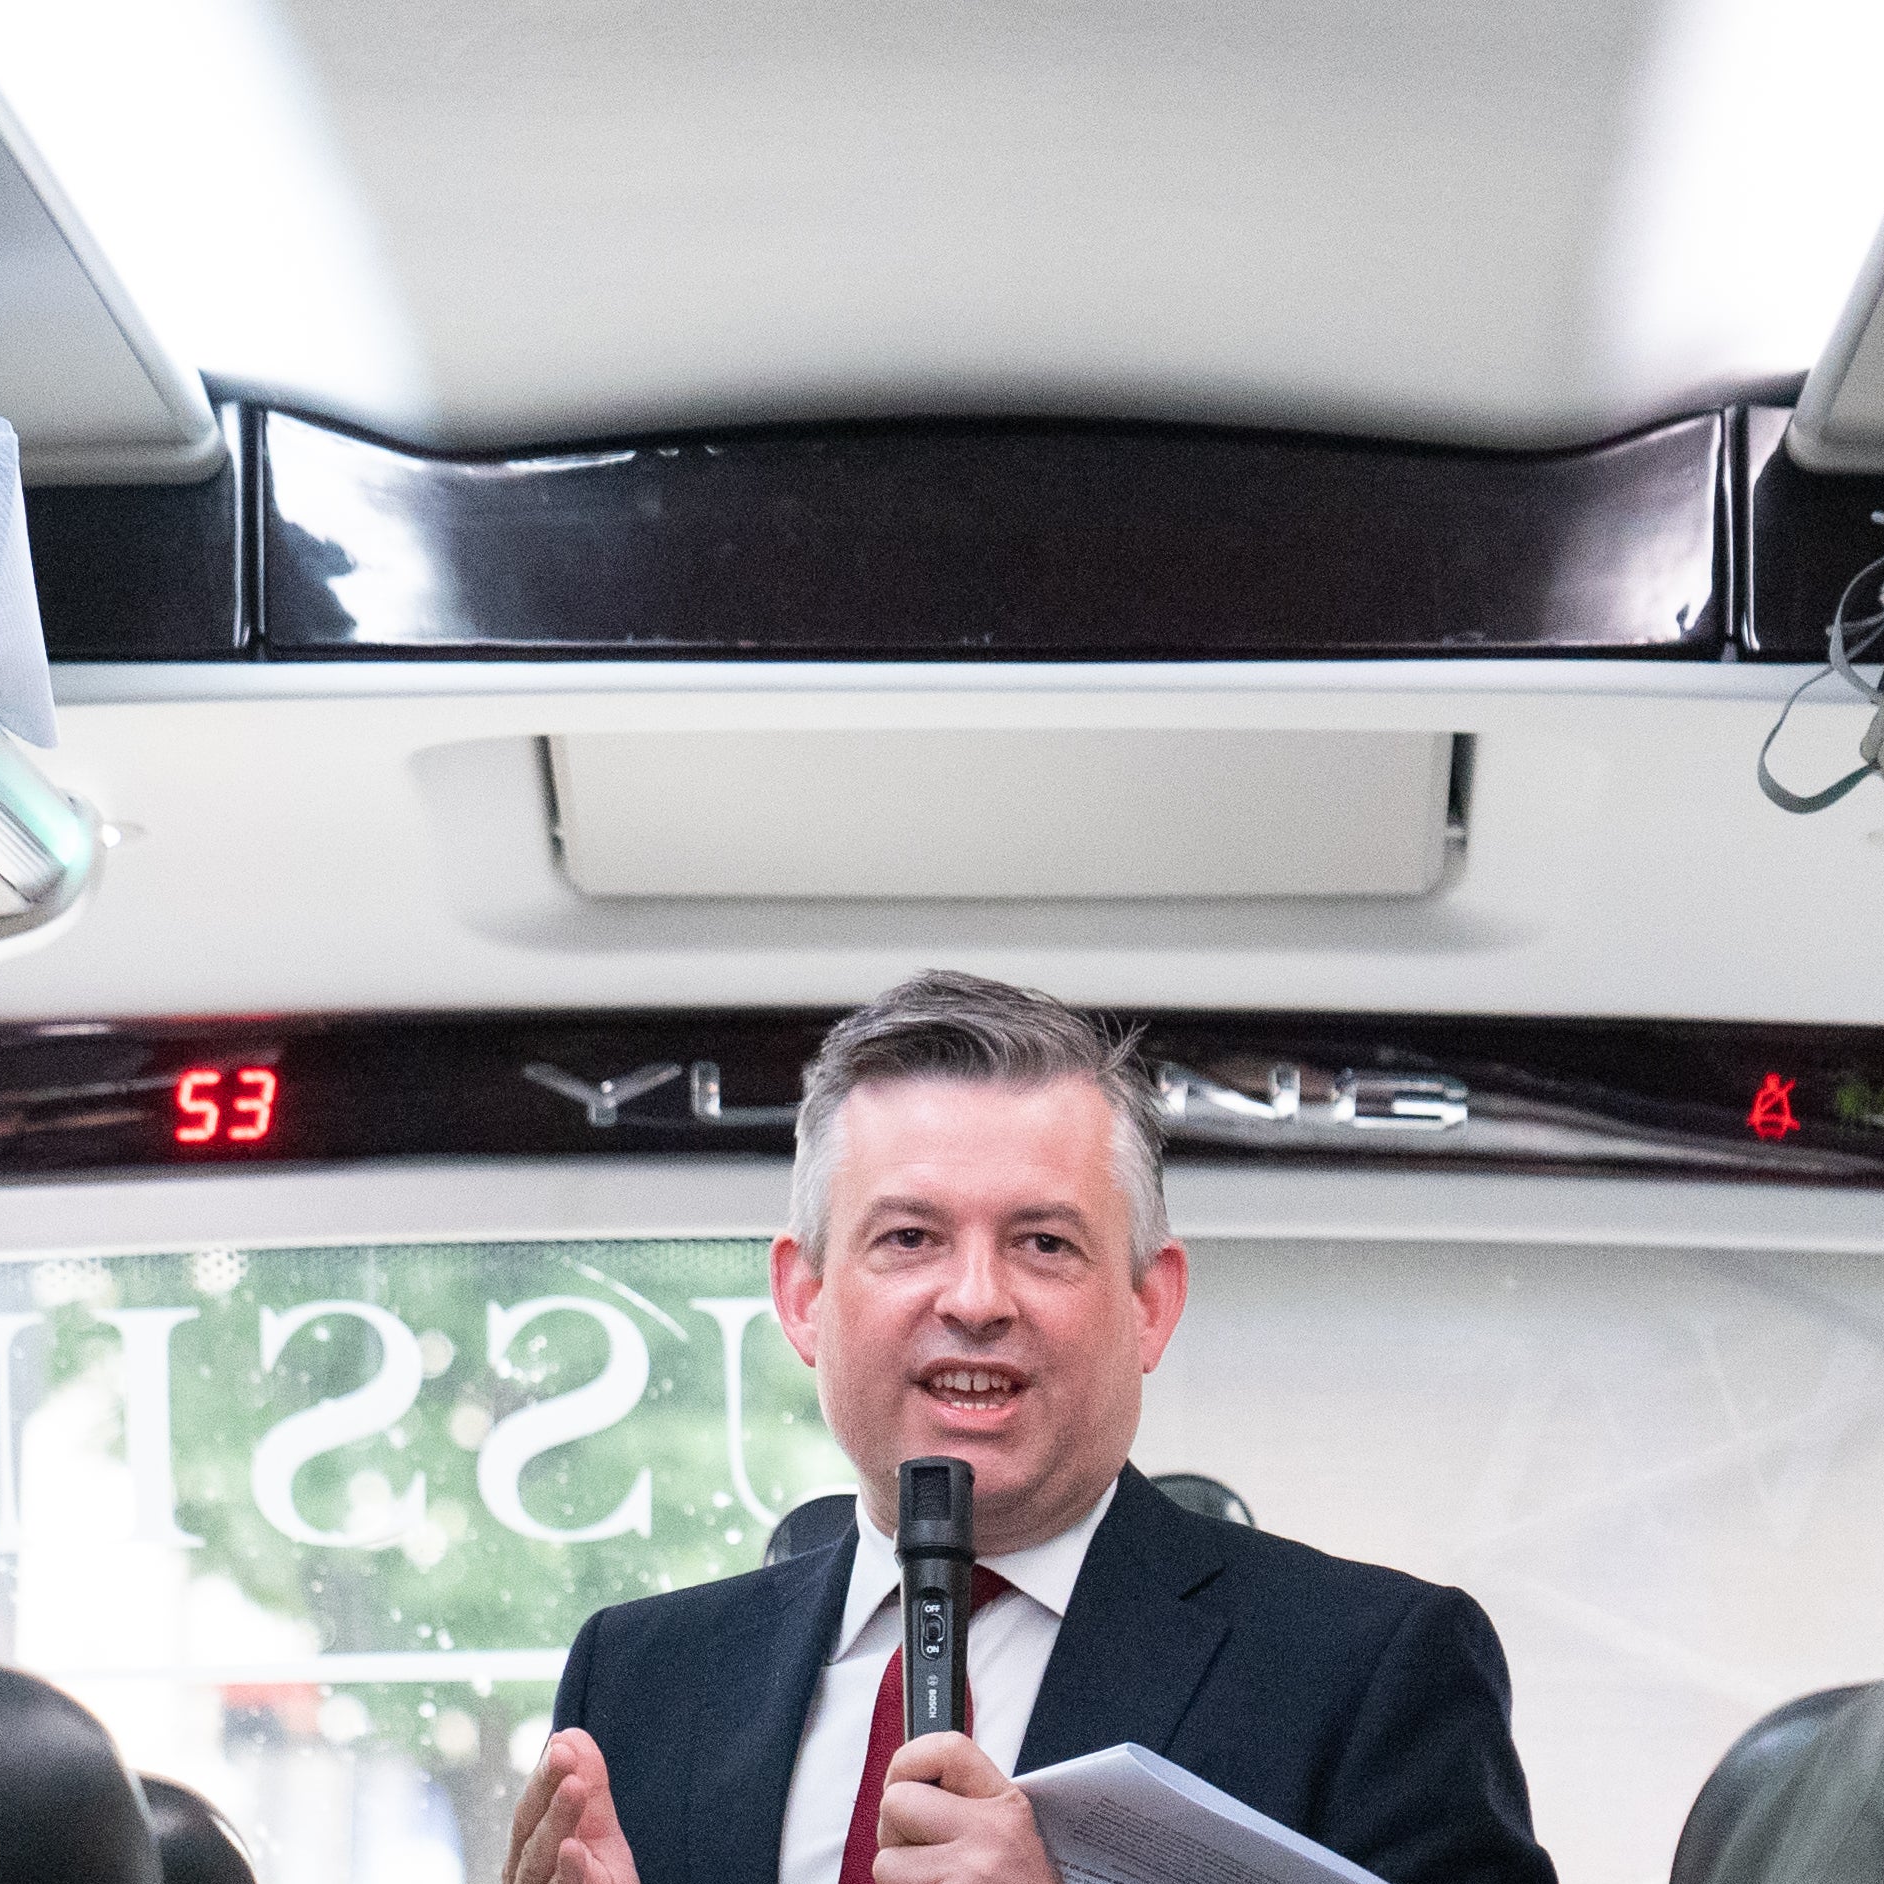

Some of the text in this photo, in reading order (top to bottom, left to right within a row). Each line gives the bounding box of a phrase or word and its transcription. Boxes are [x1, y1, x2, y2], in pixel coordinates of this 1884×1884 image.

[174, 1067, 277, 1143] 53
[924, 1604, 941, 1613] OFF
[926, 1645, 940, 1654] ON
[928, 1688, 938, 1719] BOSCH
